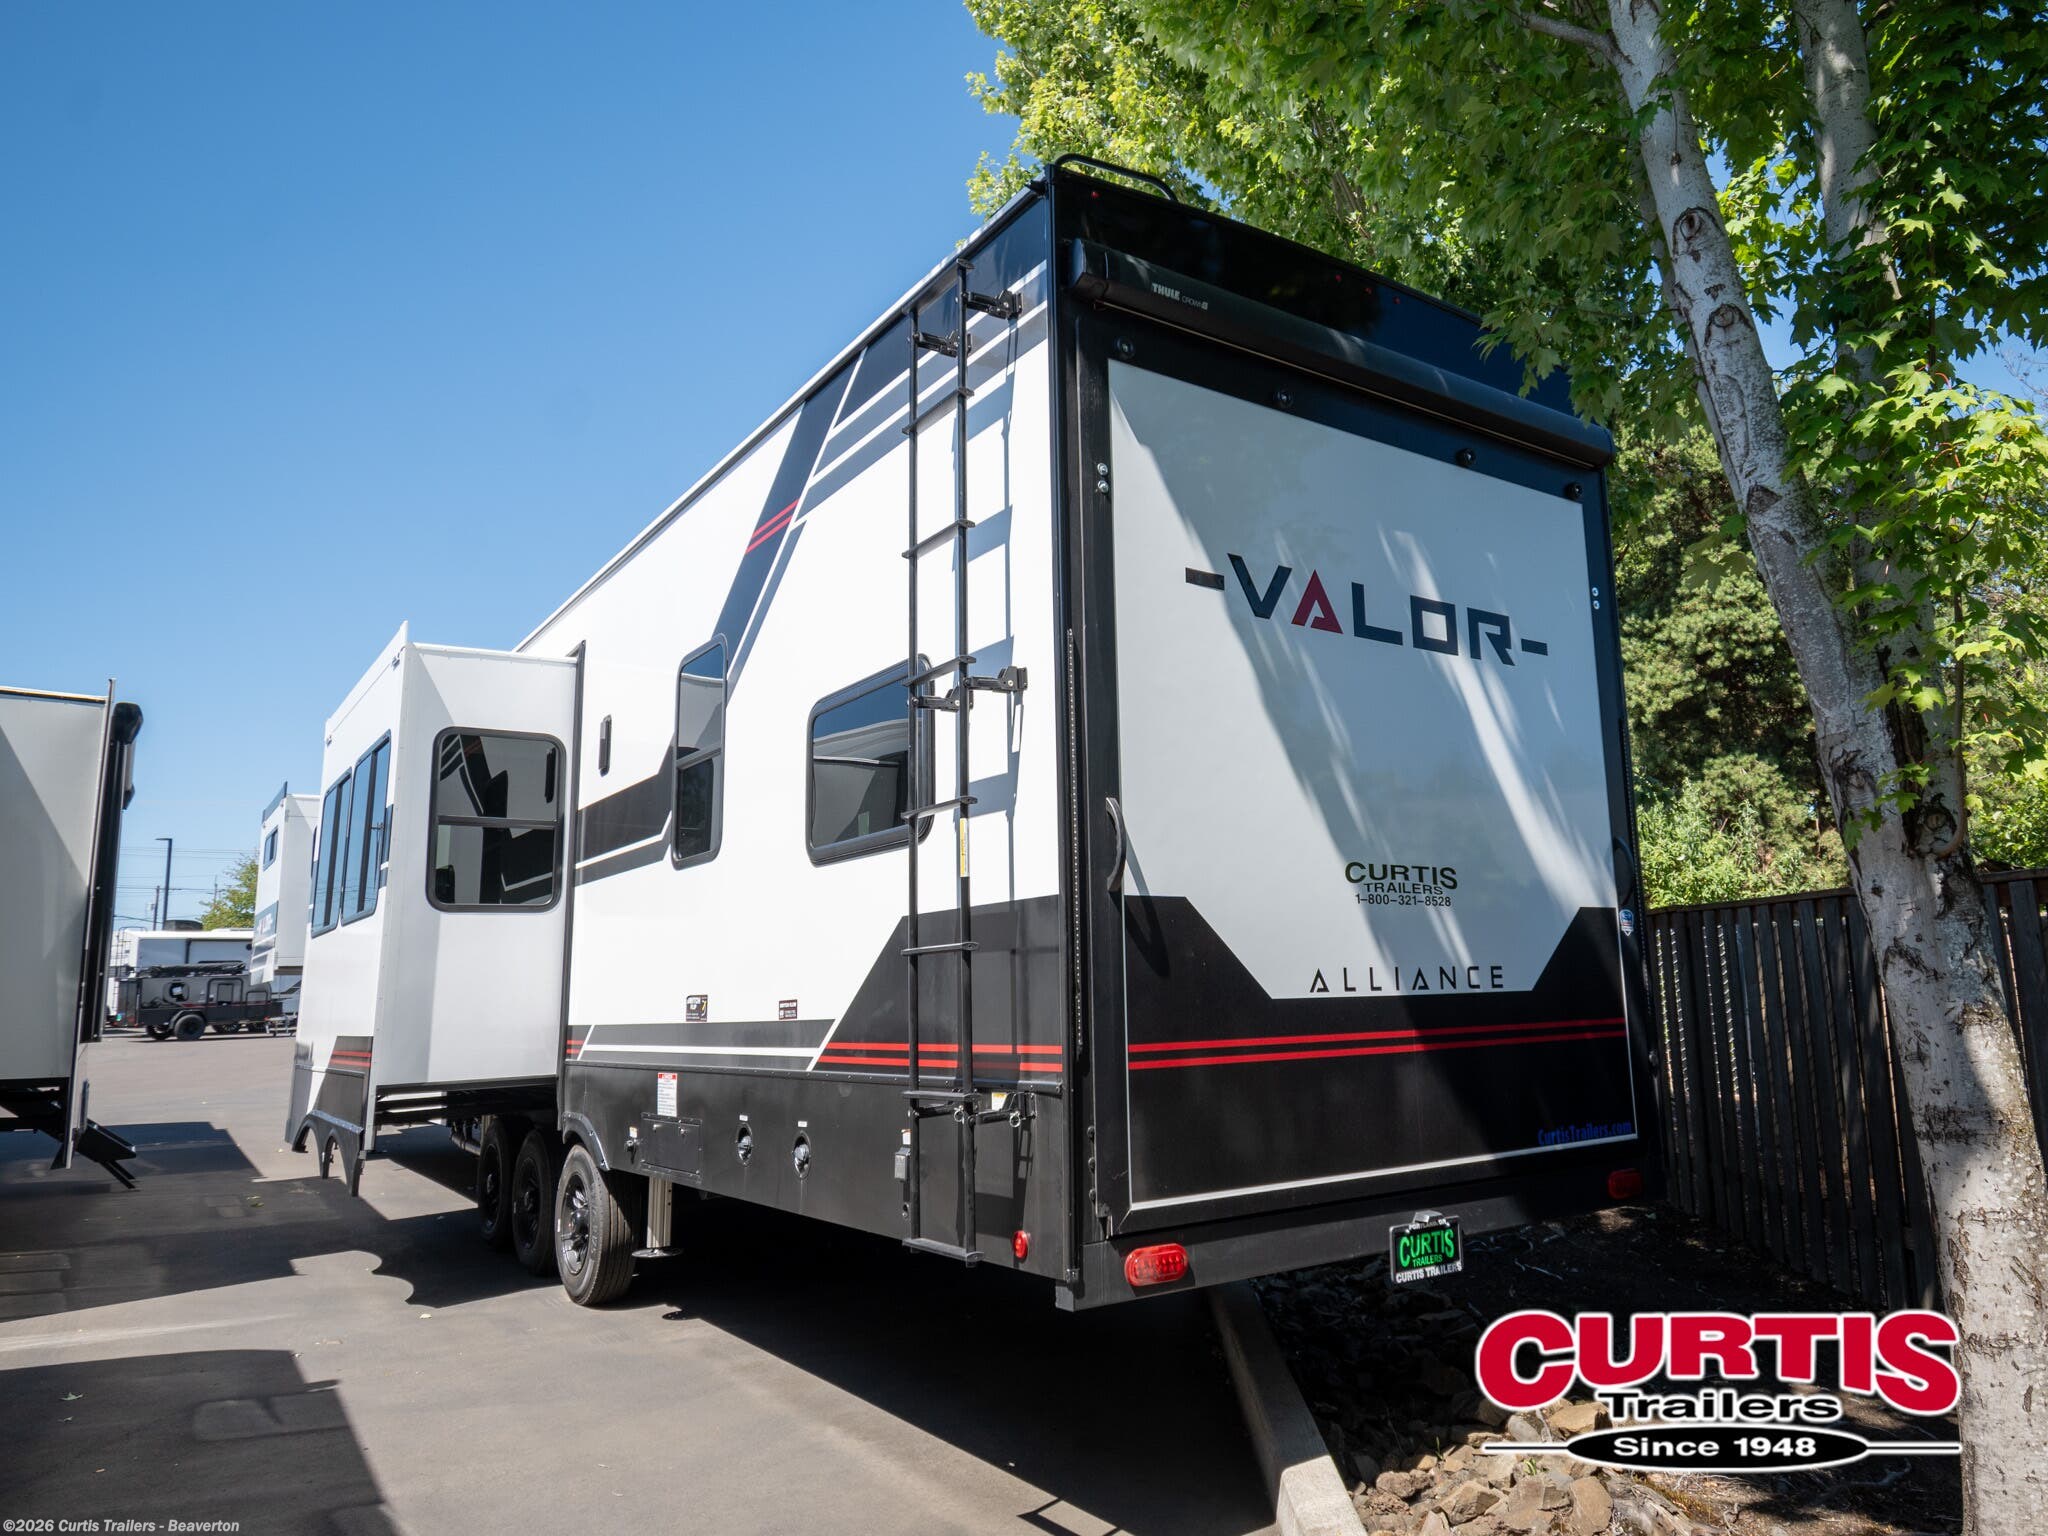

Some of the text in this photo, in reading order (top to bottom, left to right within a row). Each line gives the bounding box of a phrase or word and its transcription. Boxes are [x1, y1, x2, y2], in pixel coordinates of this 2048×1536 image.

[1152, 282, 1180, 301] THULE
[1345, 861, 1458, 890] CURTIS
[1355, 893, 1452, 907] 1-800-321-8528
[1364, 882, 1443, 895] TRAILERS
[1310, 965, 1504, 993] ALLIANCE
[1538, 1121, 1632, 1146] CurtisTrailers.com
[1399, 1228, 1455, 1268] CURTIS
[1396, 1261, 1462, 1284] CURTIS TRAILERS
[1413, 1255, 1443, 1268] TRAILERS
